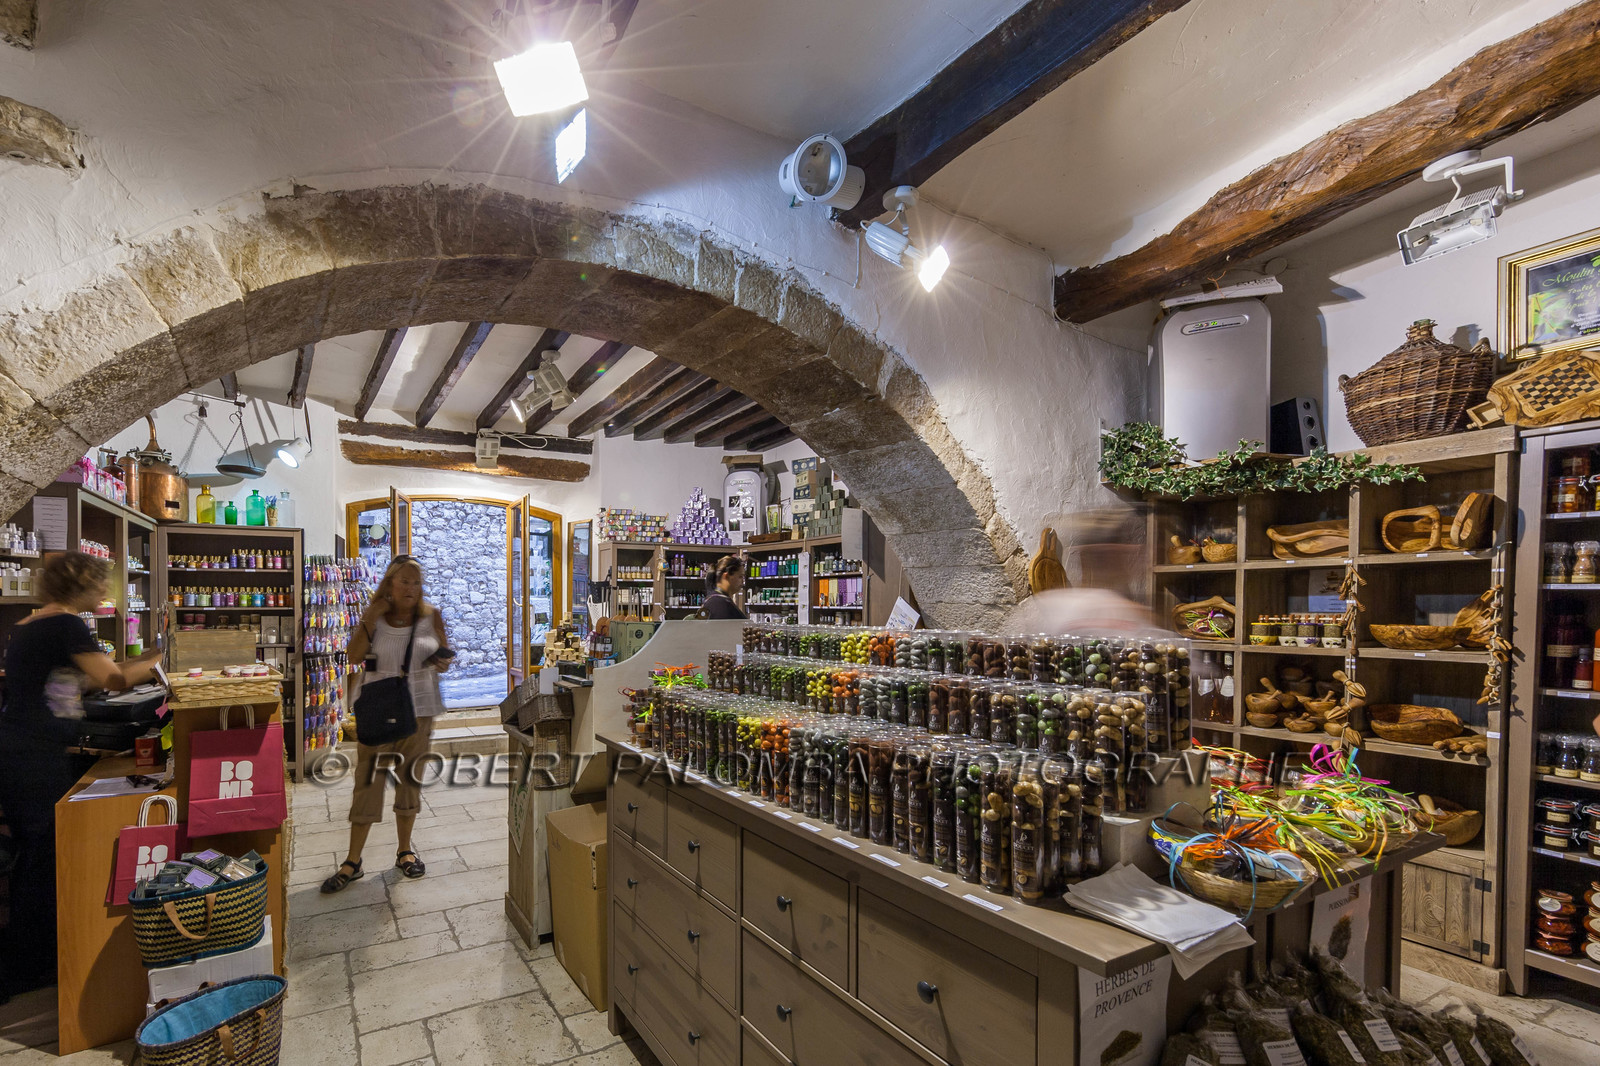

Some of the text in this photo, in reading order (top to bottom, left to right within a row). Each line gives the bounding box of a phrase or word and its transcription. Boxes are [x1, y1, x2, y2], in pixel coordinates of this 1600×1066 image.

[1542, 267, 1595, 287] Moulin
[1095, 960, 1156, 998] HERBES DE
[1094, 979, 1153, 1019] PROVENCE
